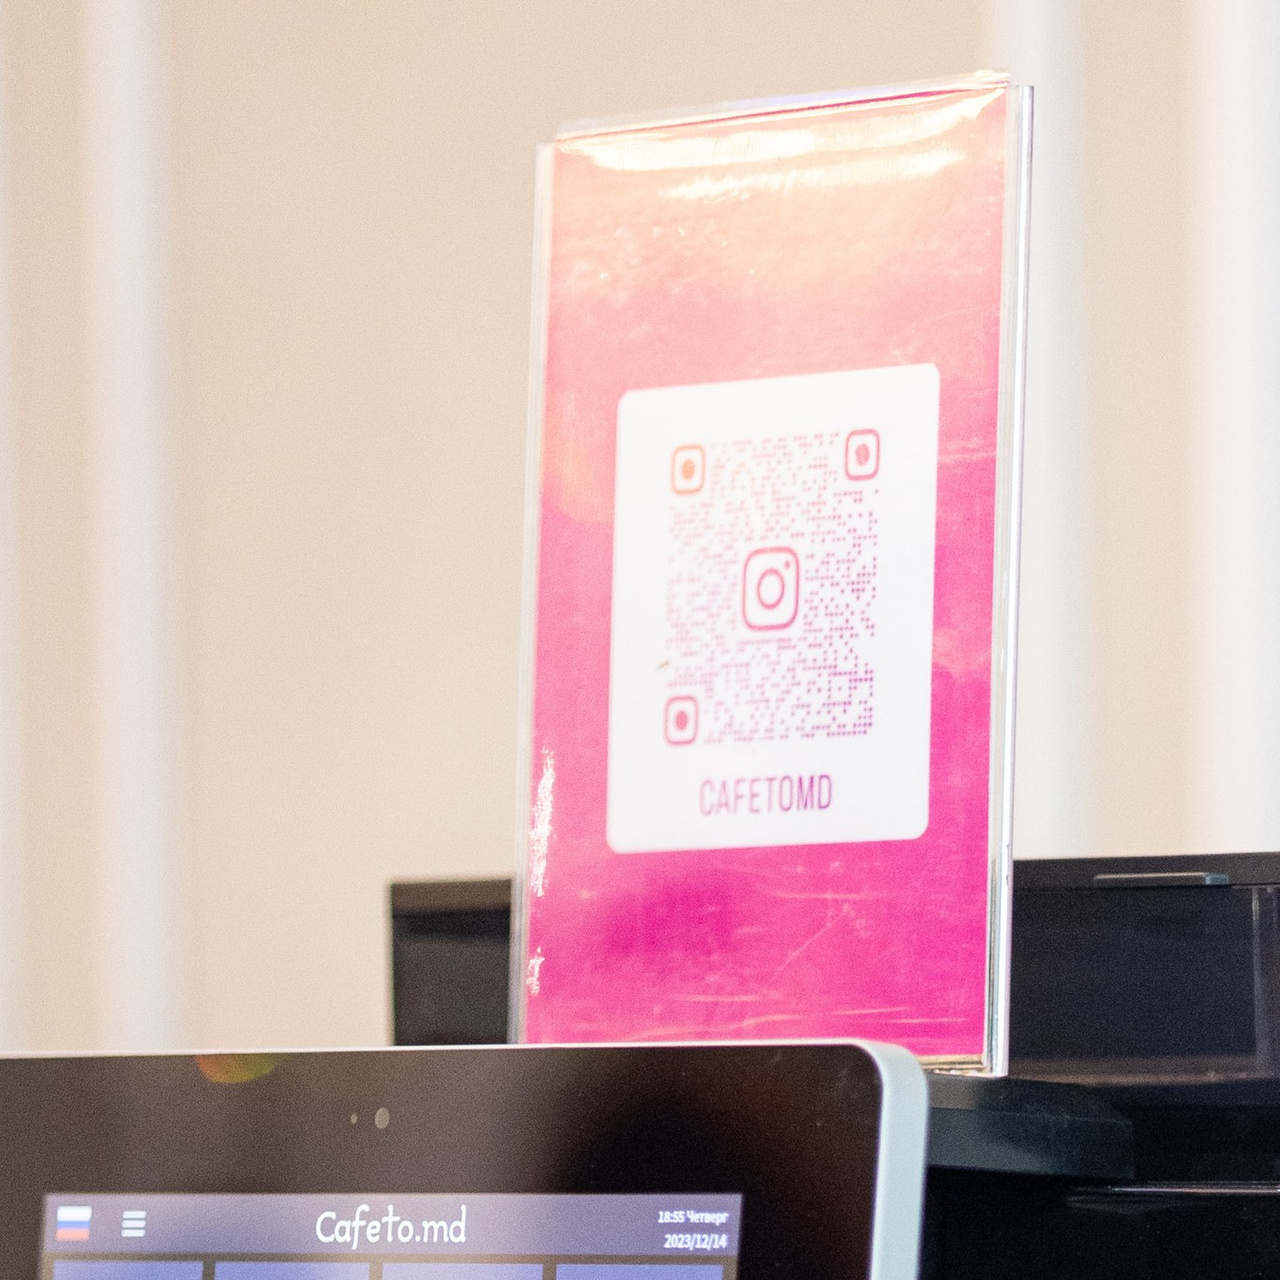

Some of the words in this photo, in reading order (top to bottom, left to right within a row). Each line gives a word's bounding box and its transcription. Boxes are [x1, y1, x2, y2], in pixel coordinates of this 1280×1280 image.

[699, 774, 834, 816] CAFETOMD
[315, 1204, 468, 1250] Cafeto.md
[658, 1210, 685, 1223] 18:55
[686, 1210, 729, 1226] Четверг
[664, 1233, 728, 1250] 2023/12/14
